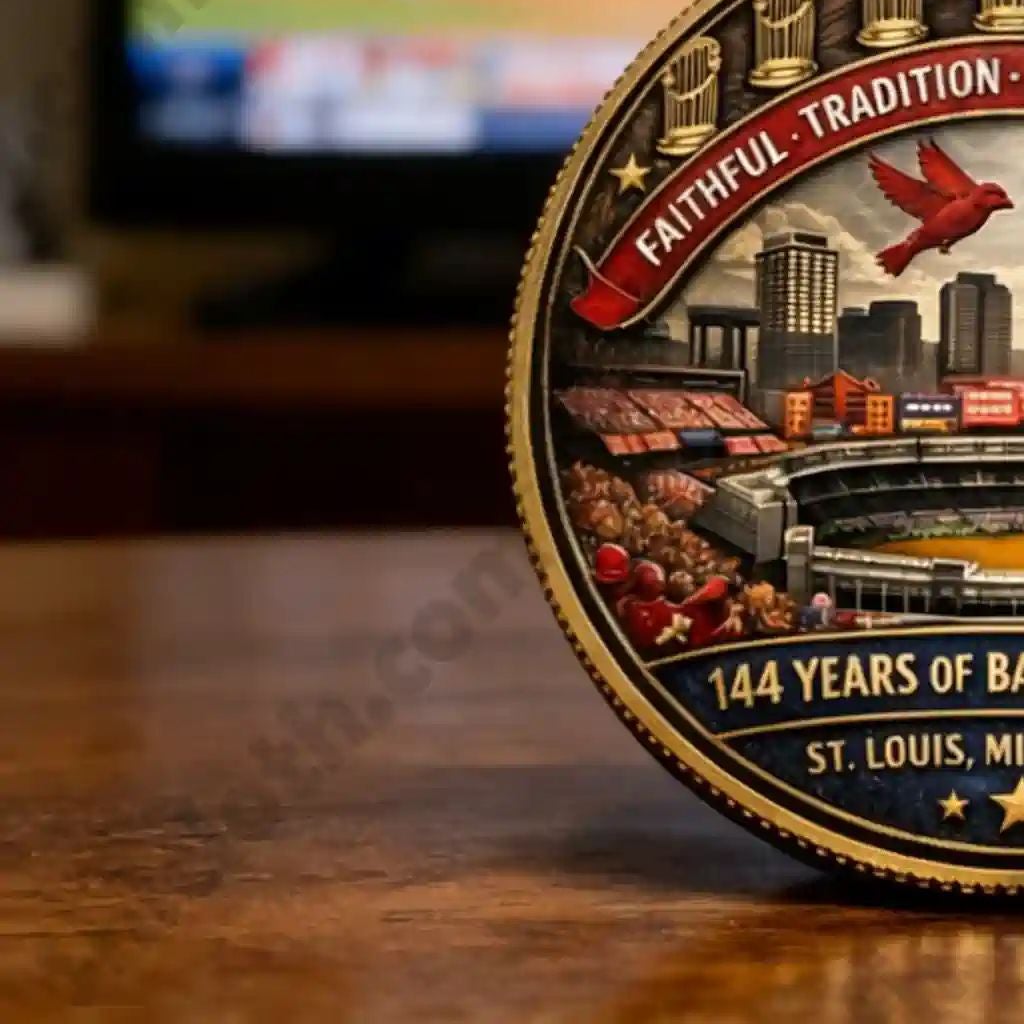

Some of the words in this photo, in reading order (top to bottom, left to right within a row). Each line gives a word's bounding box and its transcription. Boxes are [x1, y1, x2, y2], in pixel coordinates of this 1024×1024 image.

[635, 130, 789, 267] FAITHFUL
[798, 57, 1003, 139] TRADITION
[708, 661, 784, 711] 144
[792, 653, 920, 702] YEARS
[930, 653, 974, 694] OF
[805, 739, 856, 774] ST.
[866, 733, 974, 771] LOUIS,
